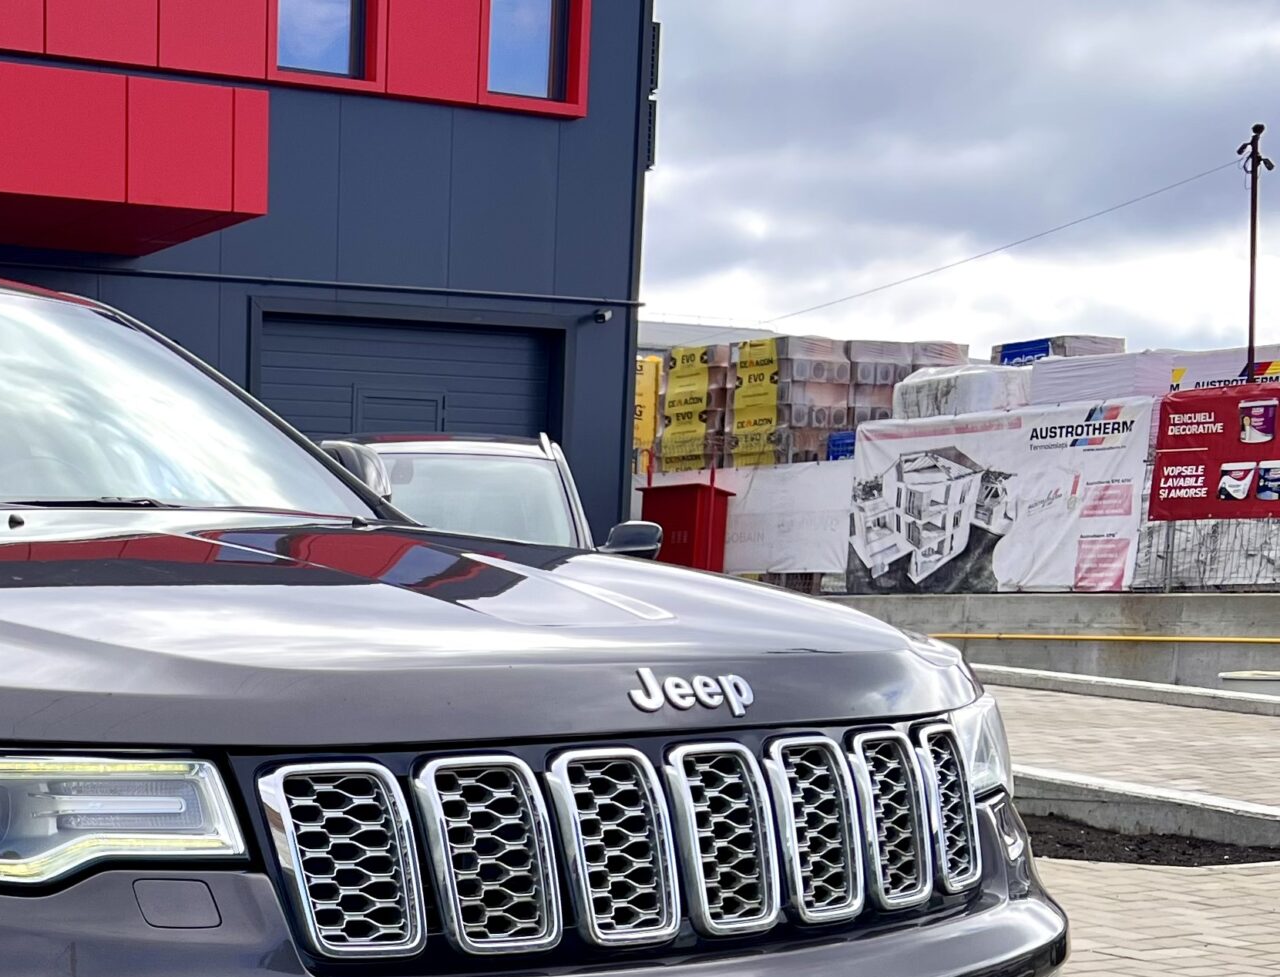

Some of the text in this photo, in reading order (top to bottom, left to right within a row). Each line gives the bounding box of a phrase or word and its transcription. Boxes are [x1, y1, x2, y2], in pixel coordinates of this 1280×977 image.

[681, 353, 696, 364] EVO
[748, 372, 765, 383] EVO
[676, 411, 693, 421] EVO
[1168, 412, 1215, 424] TENCUIELI
[1029, 420, 1135, 441] AUSTROTHERM
[1167, 423, 1224, 436] DECORATIVE
[1163, 465, 1205, 476] VOPSELE
[1160, 477, 1205, 487] LAVABILE
[1169, 487, 1208, 498] AMORSE
[628, 667, 754, 718] Jeep
